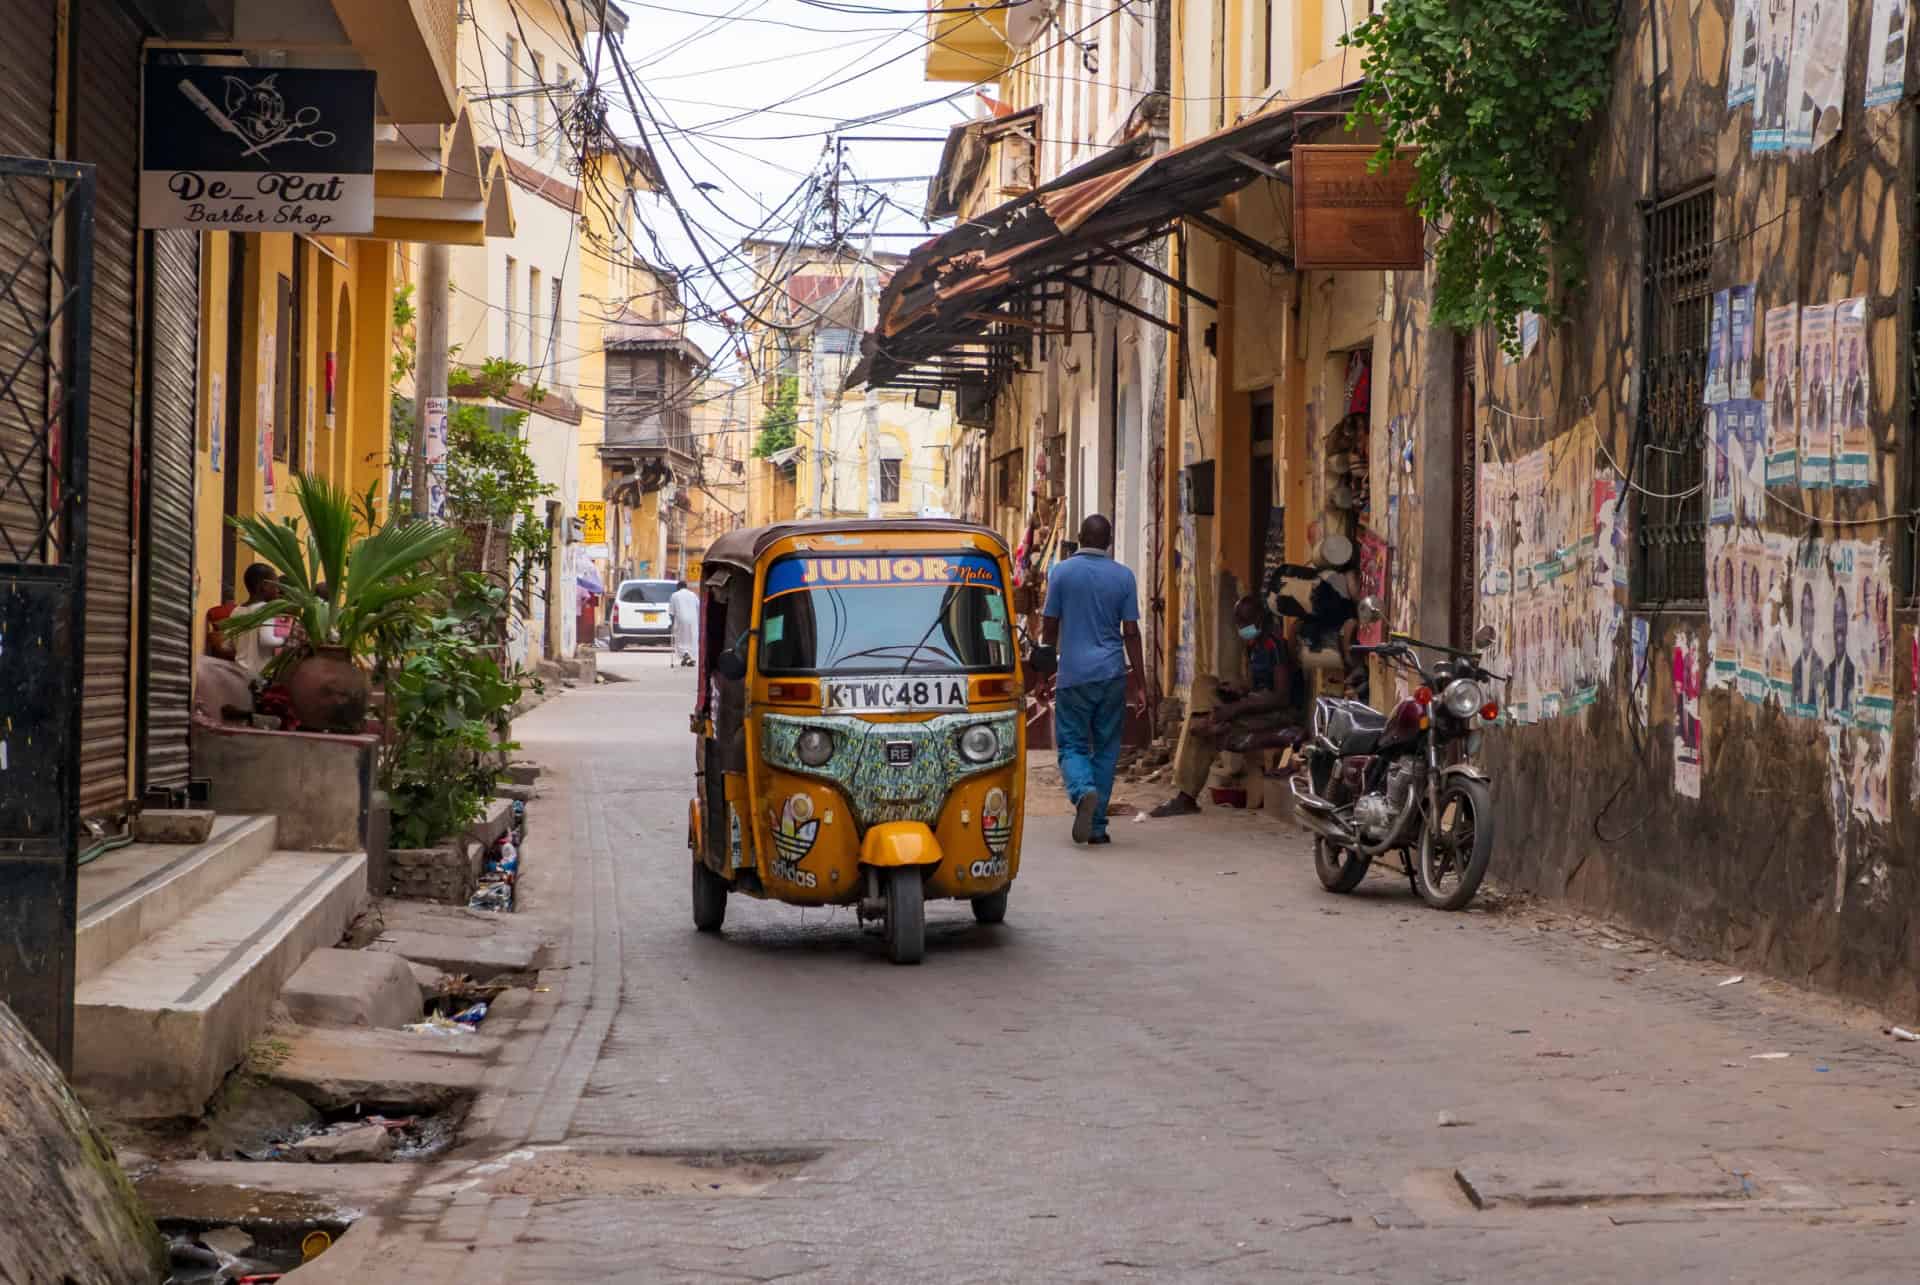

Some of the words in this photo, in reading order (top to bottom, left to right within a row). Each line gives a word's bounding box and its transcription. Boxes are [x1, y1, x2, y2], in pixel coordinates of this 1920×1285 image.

[184, 203, 267, 223] Barber
[272, 205, 334, 231] Shop
[803, 558, 948, 582] JUNIOR
[890, 749, 909, 761] RE
[770, 860, 817, 888] adidas
